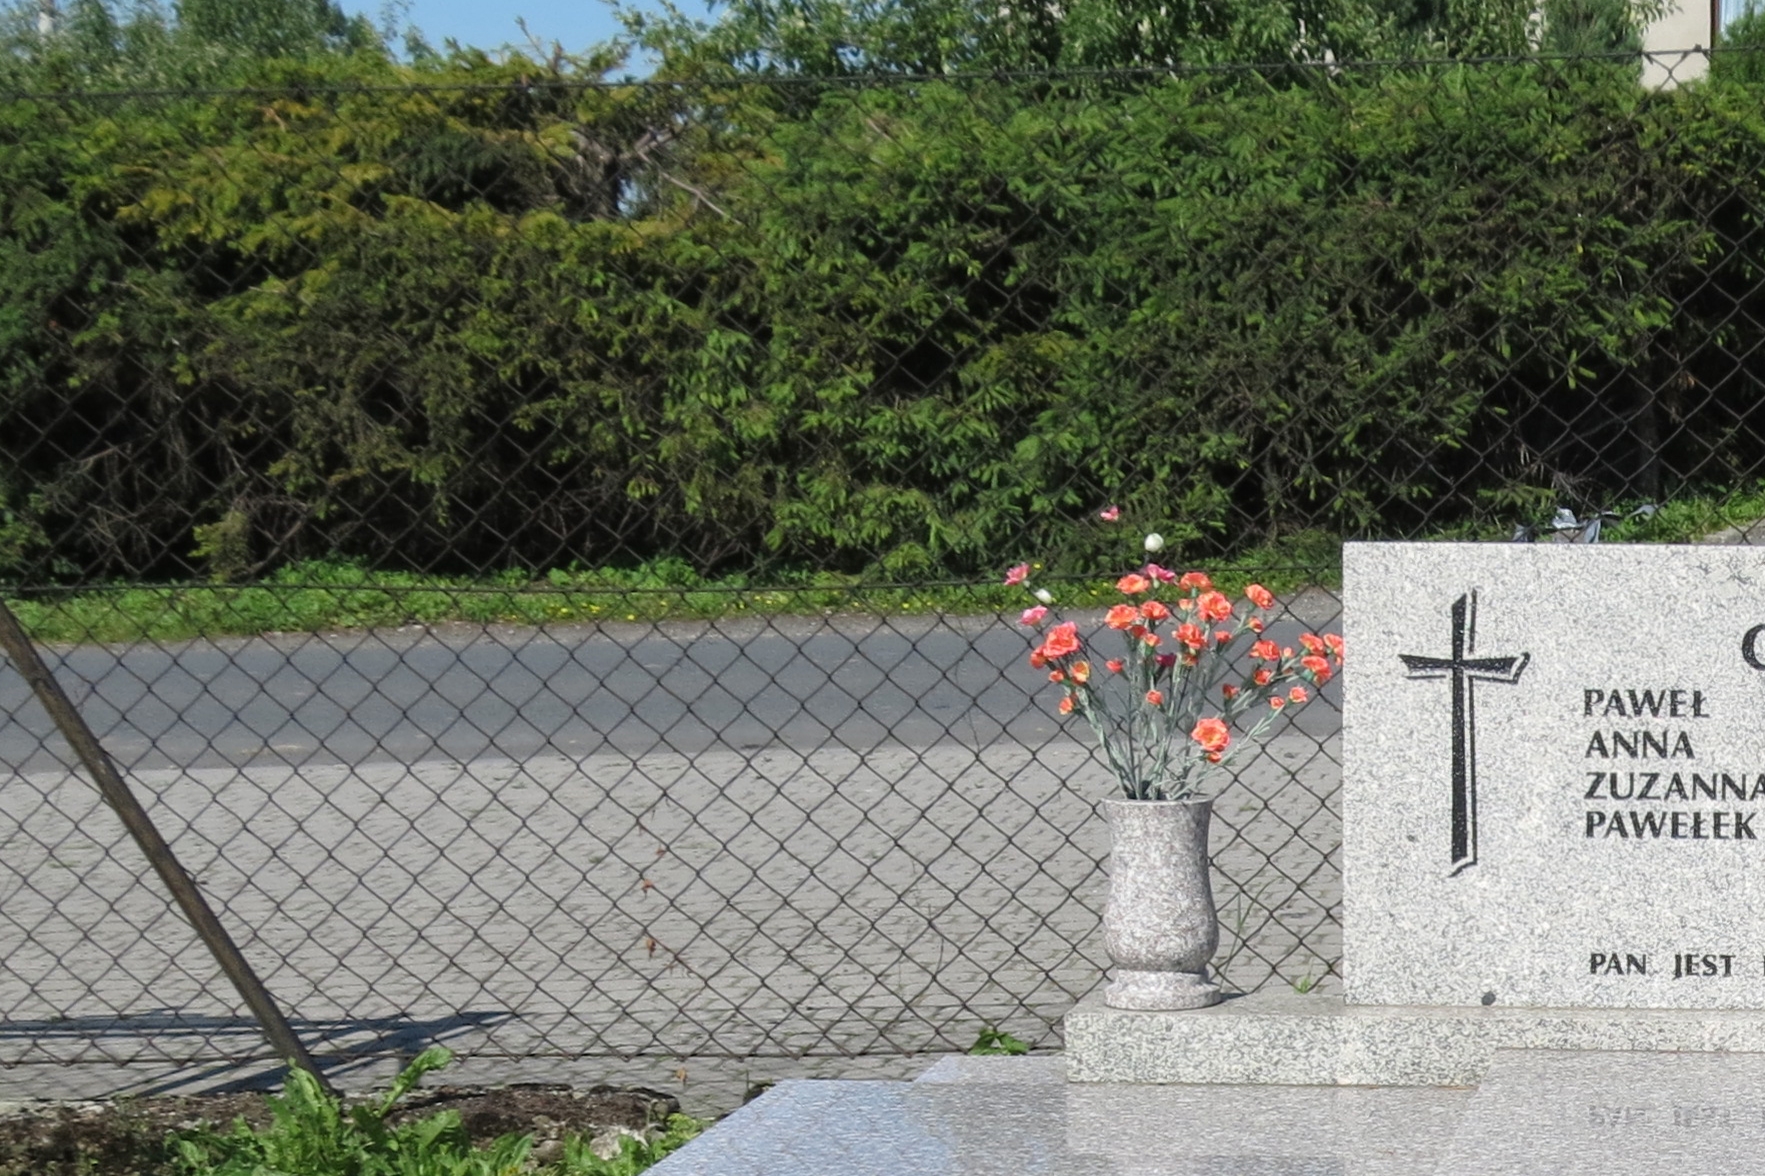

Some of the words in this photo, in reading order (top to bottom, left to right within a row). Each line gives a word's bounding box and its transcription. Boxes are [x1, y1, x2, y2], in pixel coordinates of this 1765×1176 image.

[1584, 689, 1710, 718] PAWEŁ
[1584, 729, 1695, 759] ANNA
[1585, 810, 1757, 840] PAWEŁEK
[1588, 952, 1647, 975] PAN
[1672, 953, 1736, 980] JEST
